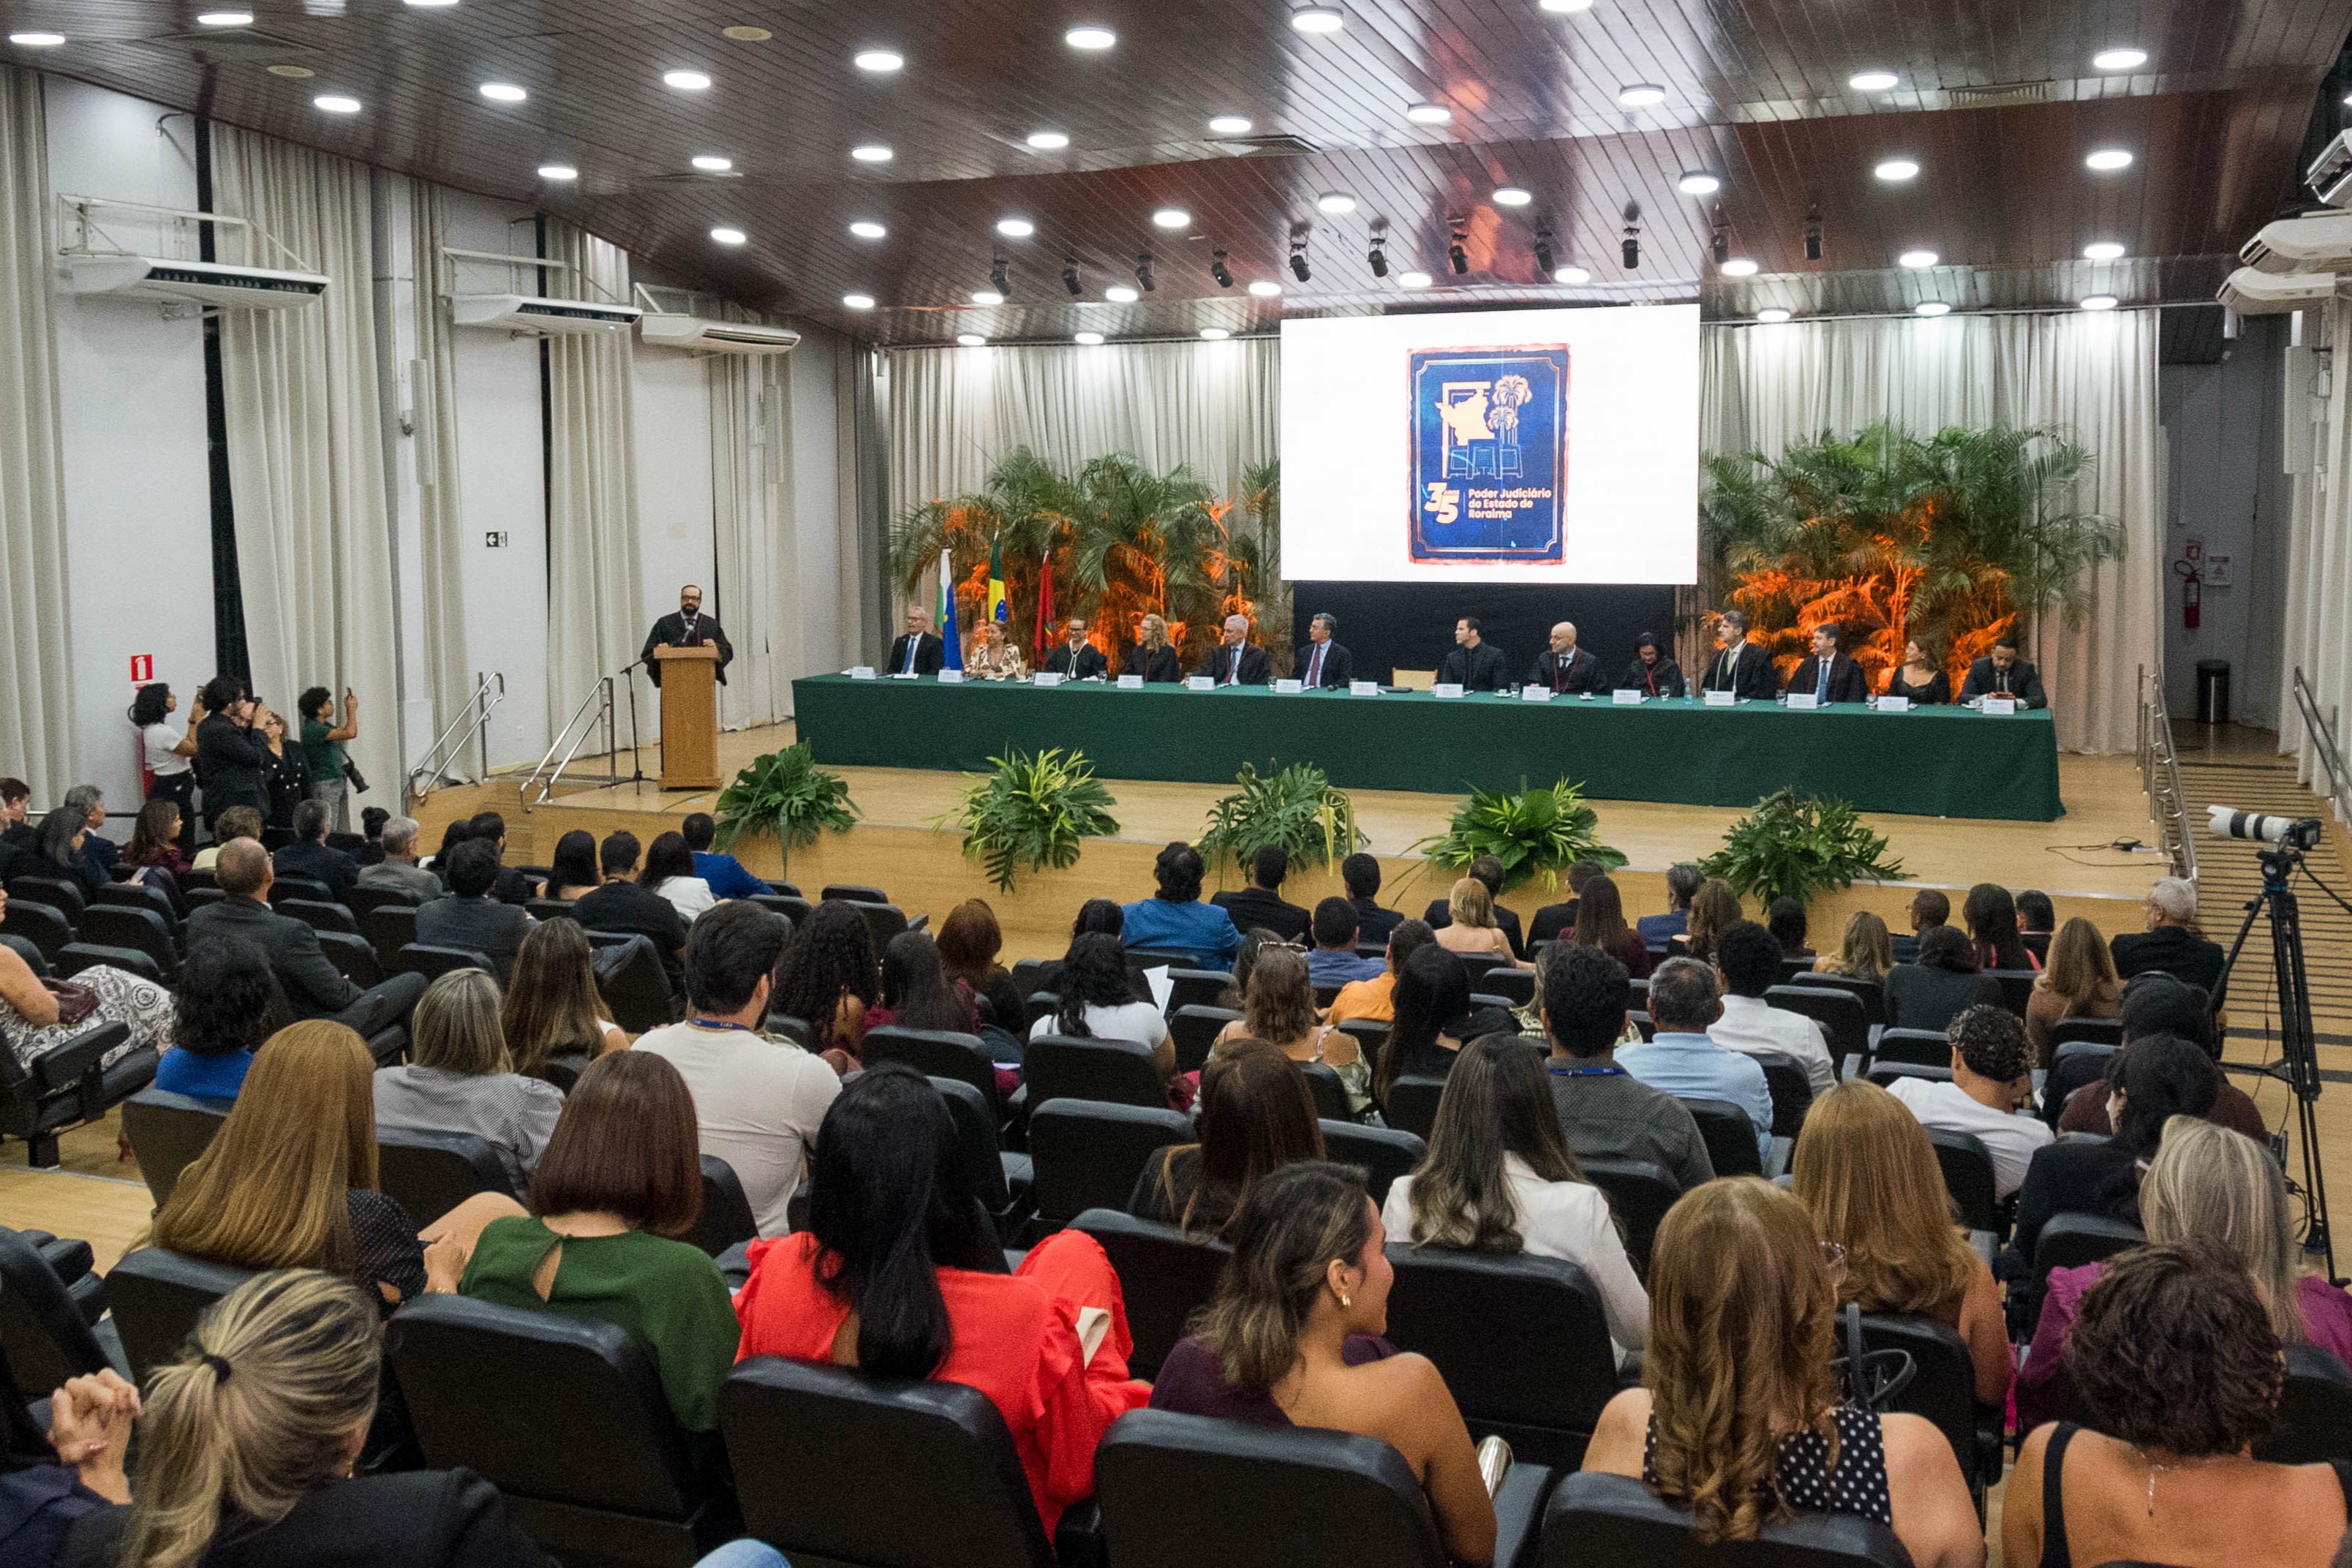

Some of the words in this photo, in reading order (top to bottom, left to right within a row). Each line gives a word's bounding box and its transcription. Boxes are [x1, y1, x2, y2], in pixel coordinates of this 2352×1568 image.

[1468, 489, 1499, 499] Poder
[1500, 488, 1552, 499] Judiciário
[1424, 482, 1460, 524] 35
[1468, 499, 1482, 508] do
[1483, 499, 1518, 508] Estado
[1520, 499, 1534, 508] de
[1468, 509, 1512, 519] Roraima
